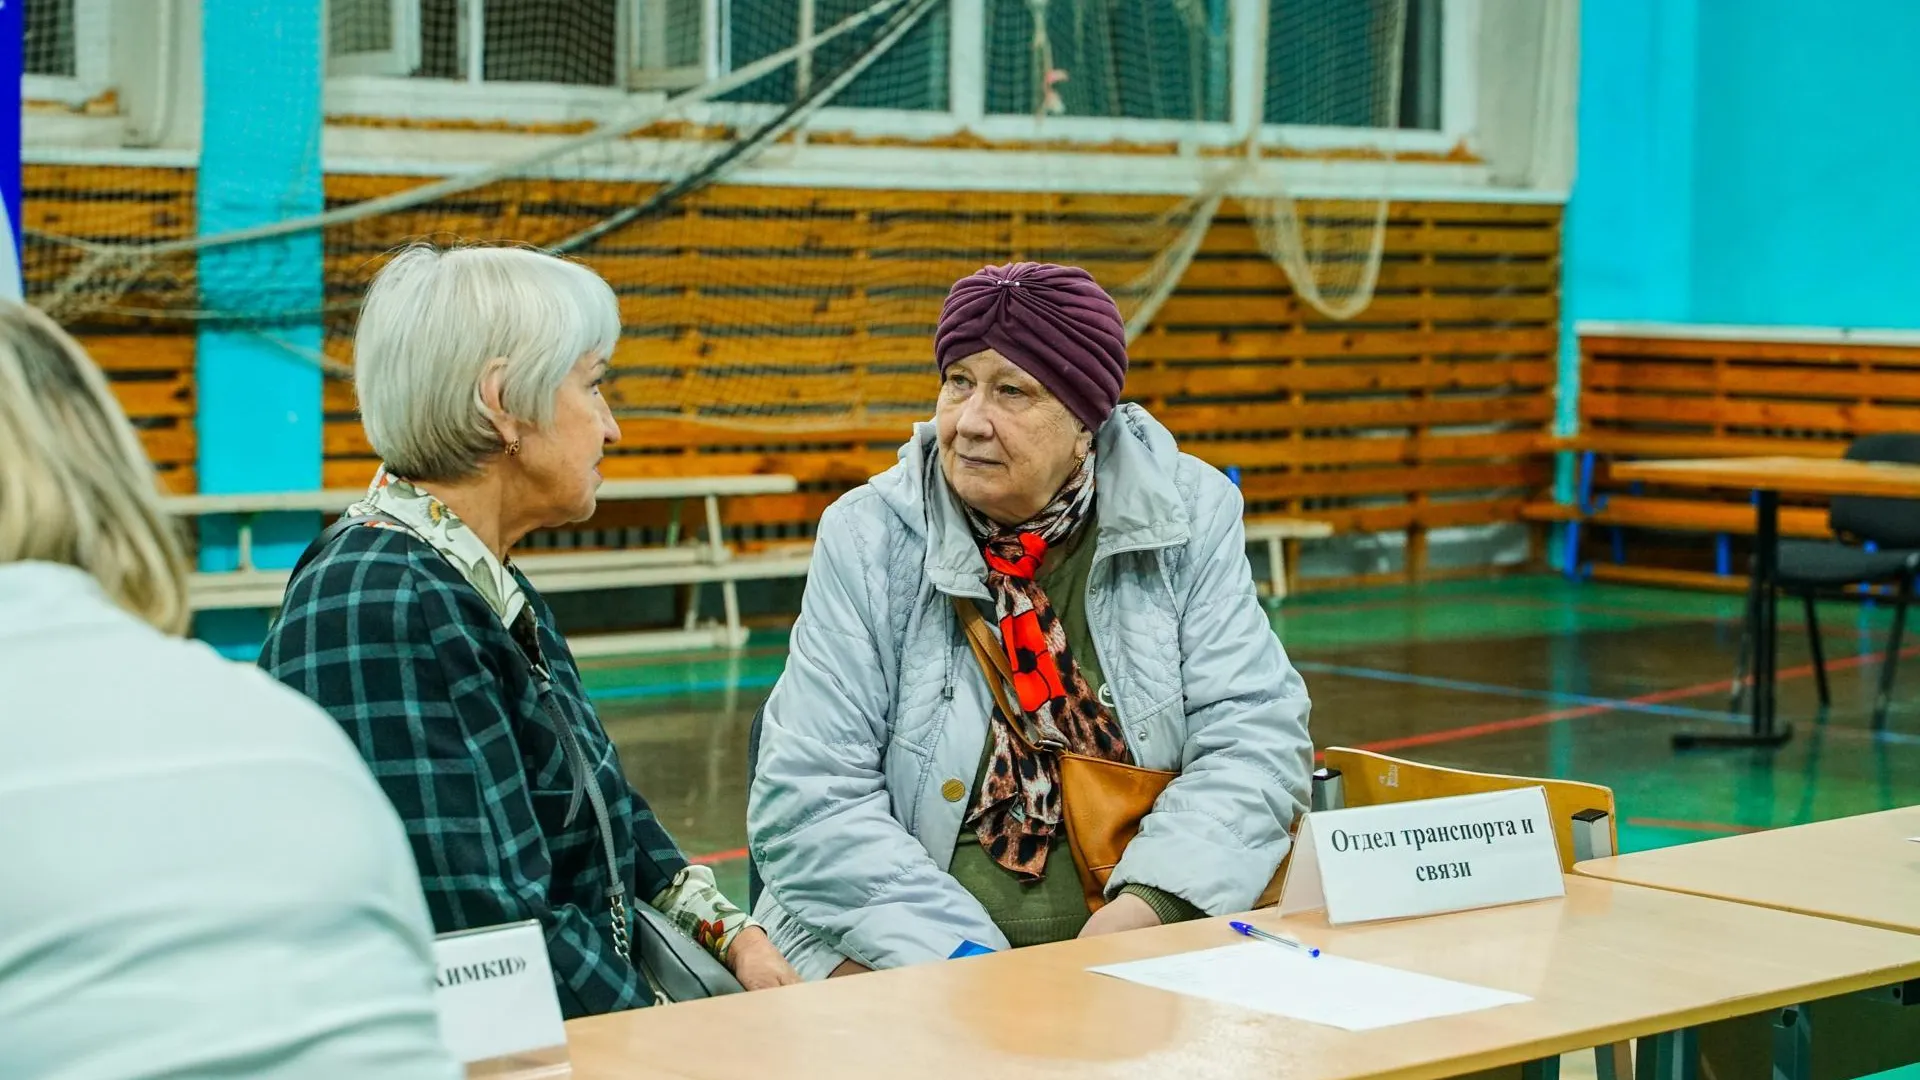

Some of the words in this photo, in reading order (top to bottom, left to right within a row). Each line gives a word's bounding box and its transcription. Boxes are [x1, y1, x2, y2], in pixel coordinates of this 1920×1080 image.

[1331, 828, 1396, 853] Отдел
[1400, 820, 1517, 851] транспорта
[1520, 817, 1534, 834] и
[1415, 860, 1472, 882] связи
